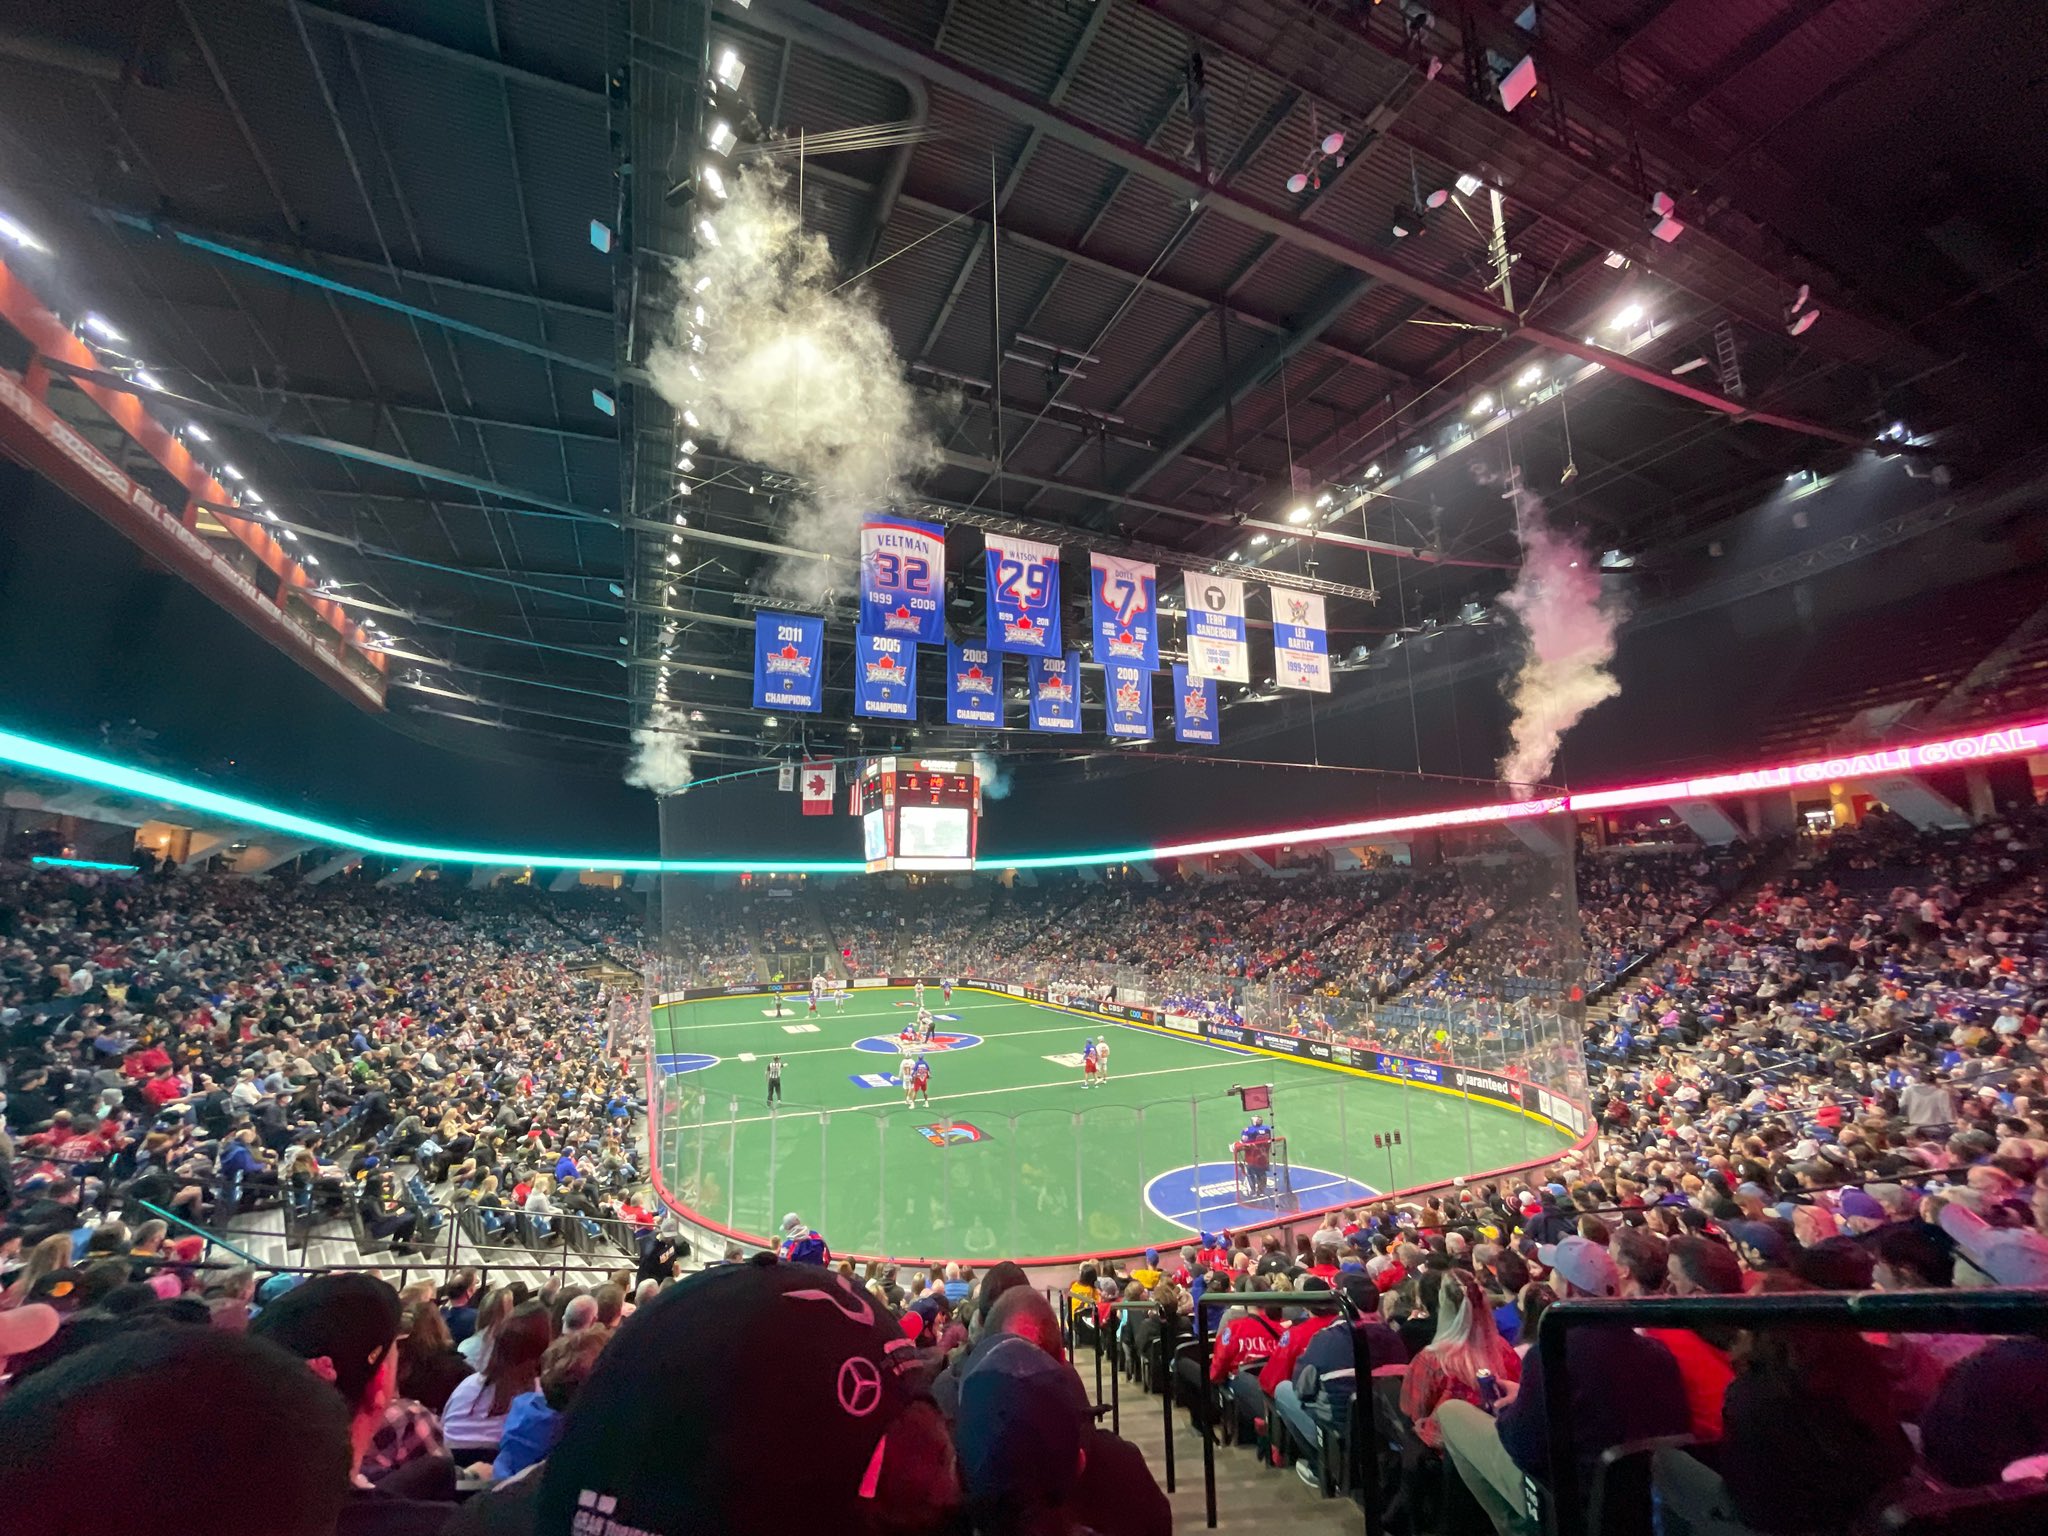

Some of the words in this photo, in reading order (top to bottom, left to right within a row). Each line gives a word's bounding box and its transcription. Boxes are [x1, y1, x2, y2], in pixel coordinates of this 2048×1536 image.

[877, 534, 930, 554] VELTMAN
[1009, 550, 1038, 562] WATSON
[874, 551, 931, 595] 32
[1115, 569, 1134, 581] DOYLE
[995, 558, 1051, 608] 29
[868, 591, 893, 605] 1999
[910, 597, 937, 611] 2008
[1114, 578, 1136, 621] 7
[1205, 613, 1227, 627] TERRY
[777, 626, 802, 642] 2011
[1196, 623, 1237, 640] SANDERSON
[1295, 626, 1306, 639] LES
[872, 636, 901, 653] 2005
[1287, 636, 1315, 651] BARTLEY
[962, 648, 988, 664] 2003
[1043, 658, 1067, 673] 2002
[1286, 660, 1319, 675] 1999-2004
[1117, 667, 1139, 682] 2000
[1186, 675, 1205, 688] 1999
[765, 692, 812, 707] CHAMPIONS
[865, 700, 908, 714] CHAMPIONS
[956, 709, 995, 722] CHAMPIONS
[1038, 716, 1076, 730] CHAMPIONS
[1114, 723, 1147, 734] CHAMPIONS
[1182, 729, 1213, 740] CHAMPIONS
[1796, 748, 1912, 783] GOAL!
[1919, 728, 2037, 765] GOAL
[1108, 1004, 1125, 1013] CBSF
[1455, 1073, 1509, 1095] guaranteed
